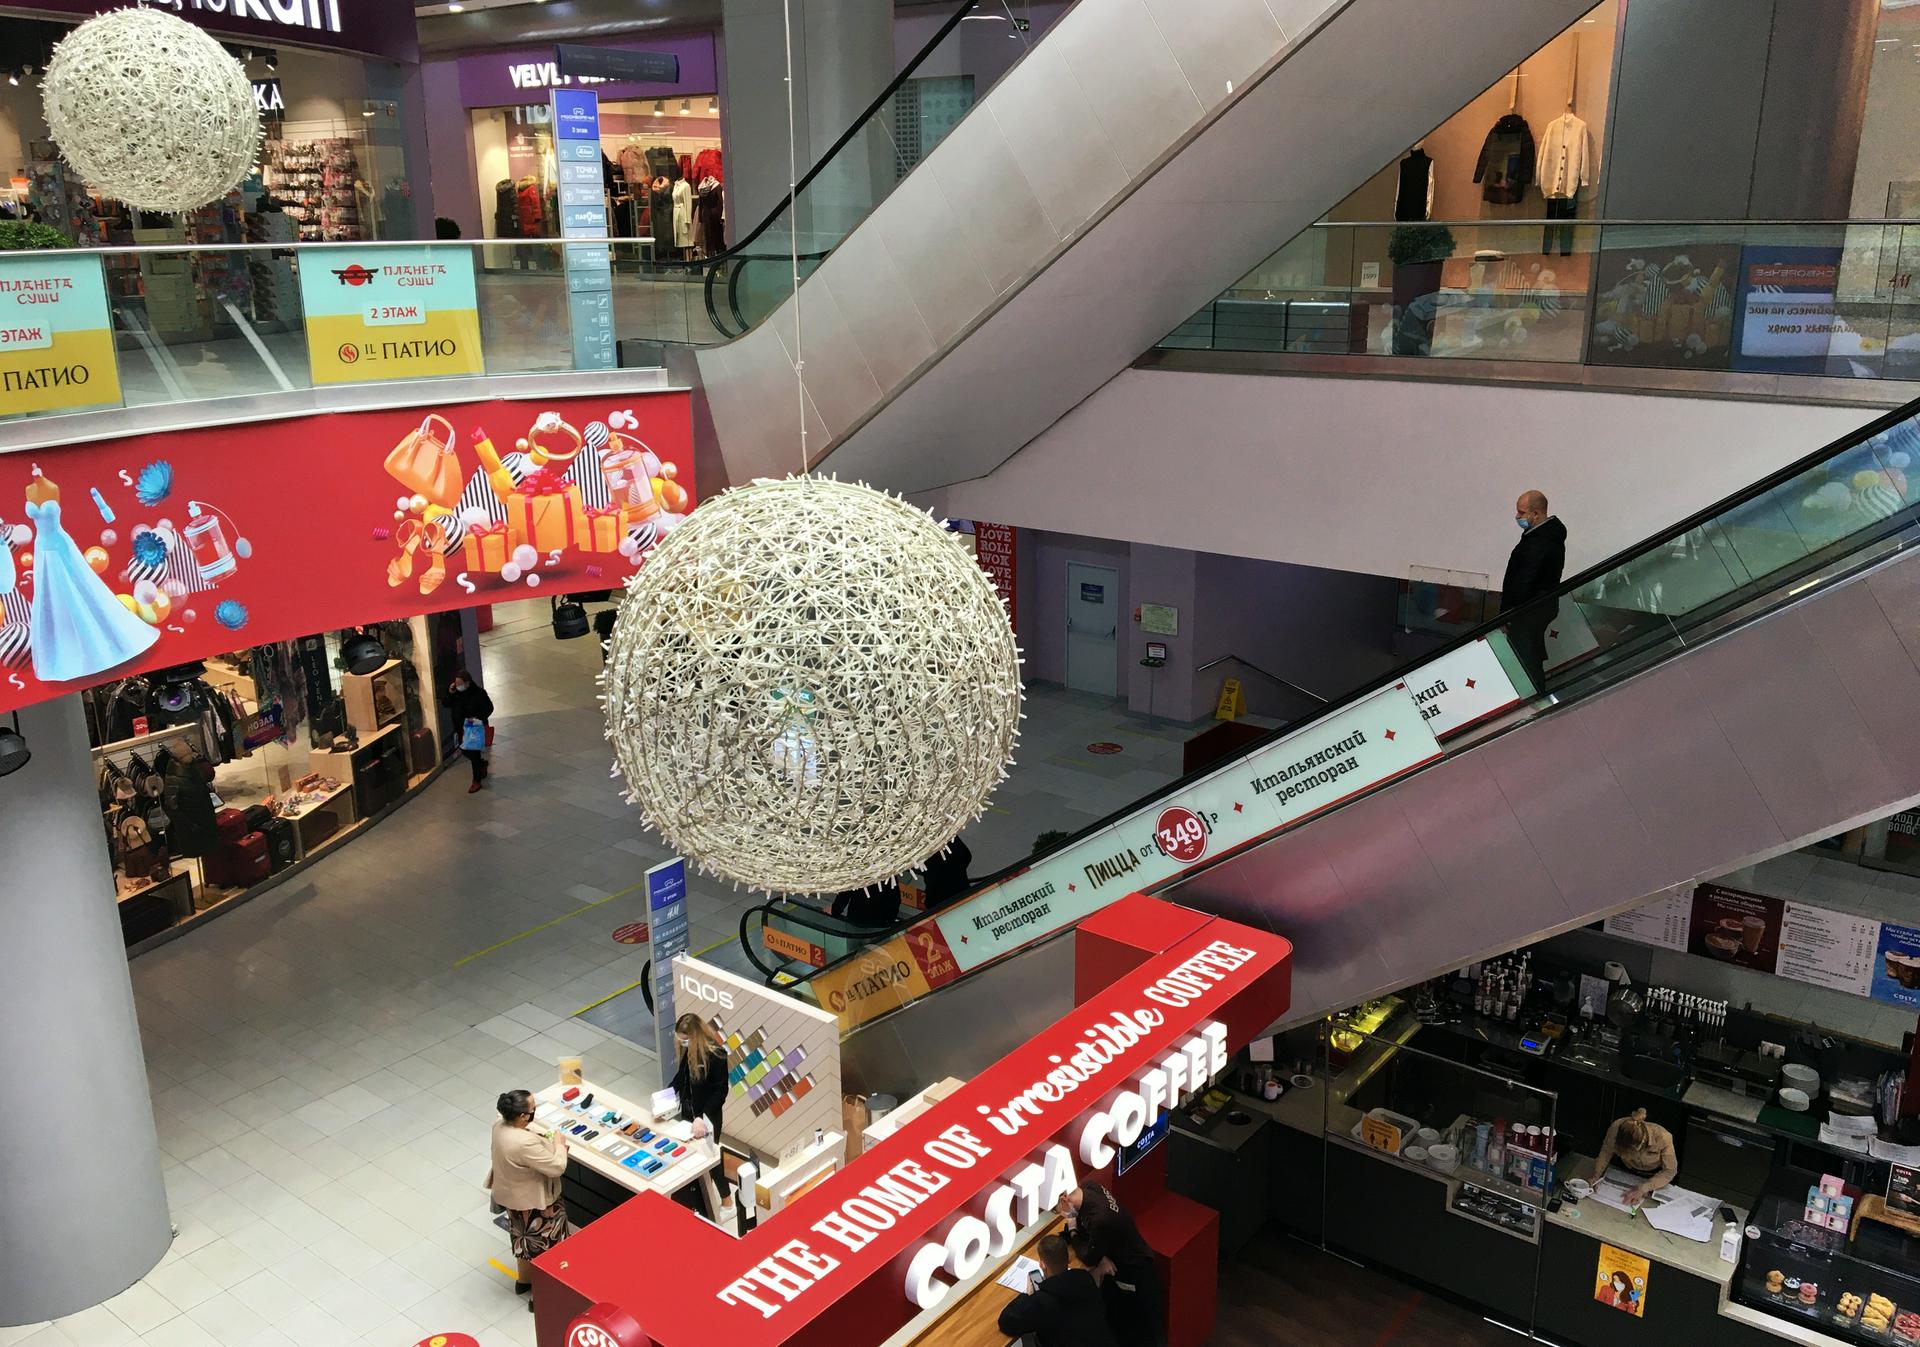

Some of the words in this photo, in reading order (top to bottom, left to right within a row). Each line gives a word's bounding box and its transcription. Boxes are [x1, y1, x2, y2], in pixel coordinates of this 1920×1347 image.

[383, 265, 446, 276] ПЛАНЕТА
[0, 278, 73, 292] ПЛАНЕТА
[397, 277, 434, 287] СУШИ
[17, 293, 59, 305] СУШИ
[371, 308, 378, 319] 2
[382, 306, 418, 319] ЭТАЖ
[0, 327, 43, 343] ЭТАЖ
[382, 339, 456, 360] ПАТИО
[3, 365, 89, 391] ПАТИО
[980, 528, 1011, 542] LOVE
[980, 540, 1011, 554] ROLL
[980, 552, 1010, 566] WOK
[1250, 730, 1367, 795] Итальянский
[1275, 756, 1360, 806] ресторан
[1888, 821, 1917, 836] ВОЛОС
[1083, 848, 1141, 889] ПИЦЦА
[1160, 817, 1203, 852] 349
[972, 882, 1056, 930] Итальянский
[991, 903, 1051, 940] ресторан
[780, 939, 807, 956] ПАТИО
[814, 947, 823, 962] 2
[854, 961, 910, 1001] ПАТИО
[918, 932, 941, 964] 2
[927, 959, 954, 979] ЭТАЖ
[680, 974, 734, 1010] IQOS
[1893, 993, 1918, 1003] COSTA
[716, 1239, 841, 1319] THE
[810, 1158, 951, 1253] HOME
[923, 1124, 992, 1169] OF
[977, 1008, 1164, 1135] irresistible
[1143, 940, 1256, 1008] COFFEE
[1136, 1130, 1155, 1149] COSTA
[905, 1144, 1078, 1310] COSTA
[1080, 1020, 1228, 1169] COFFEE
